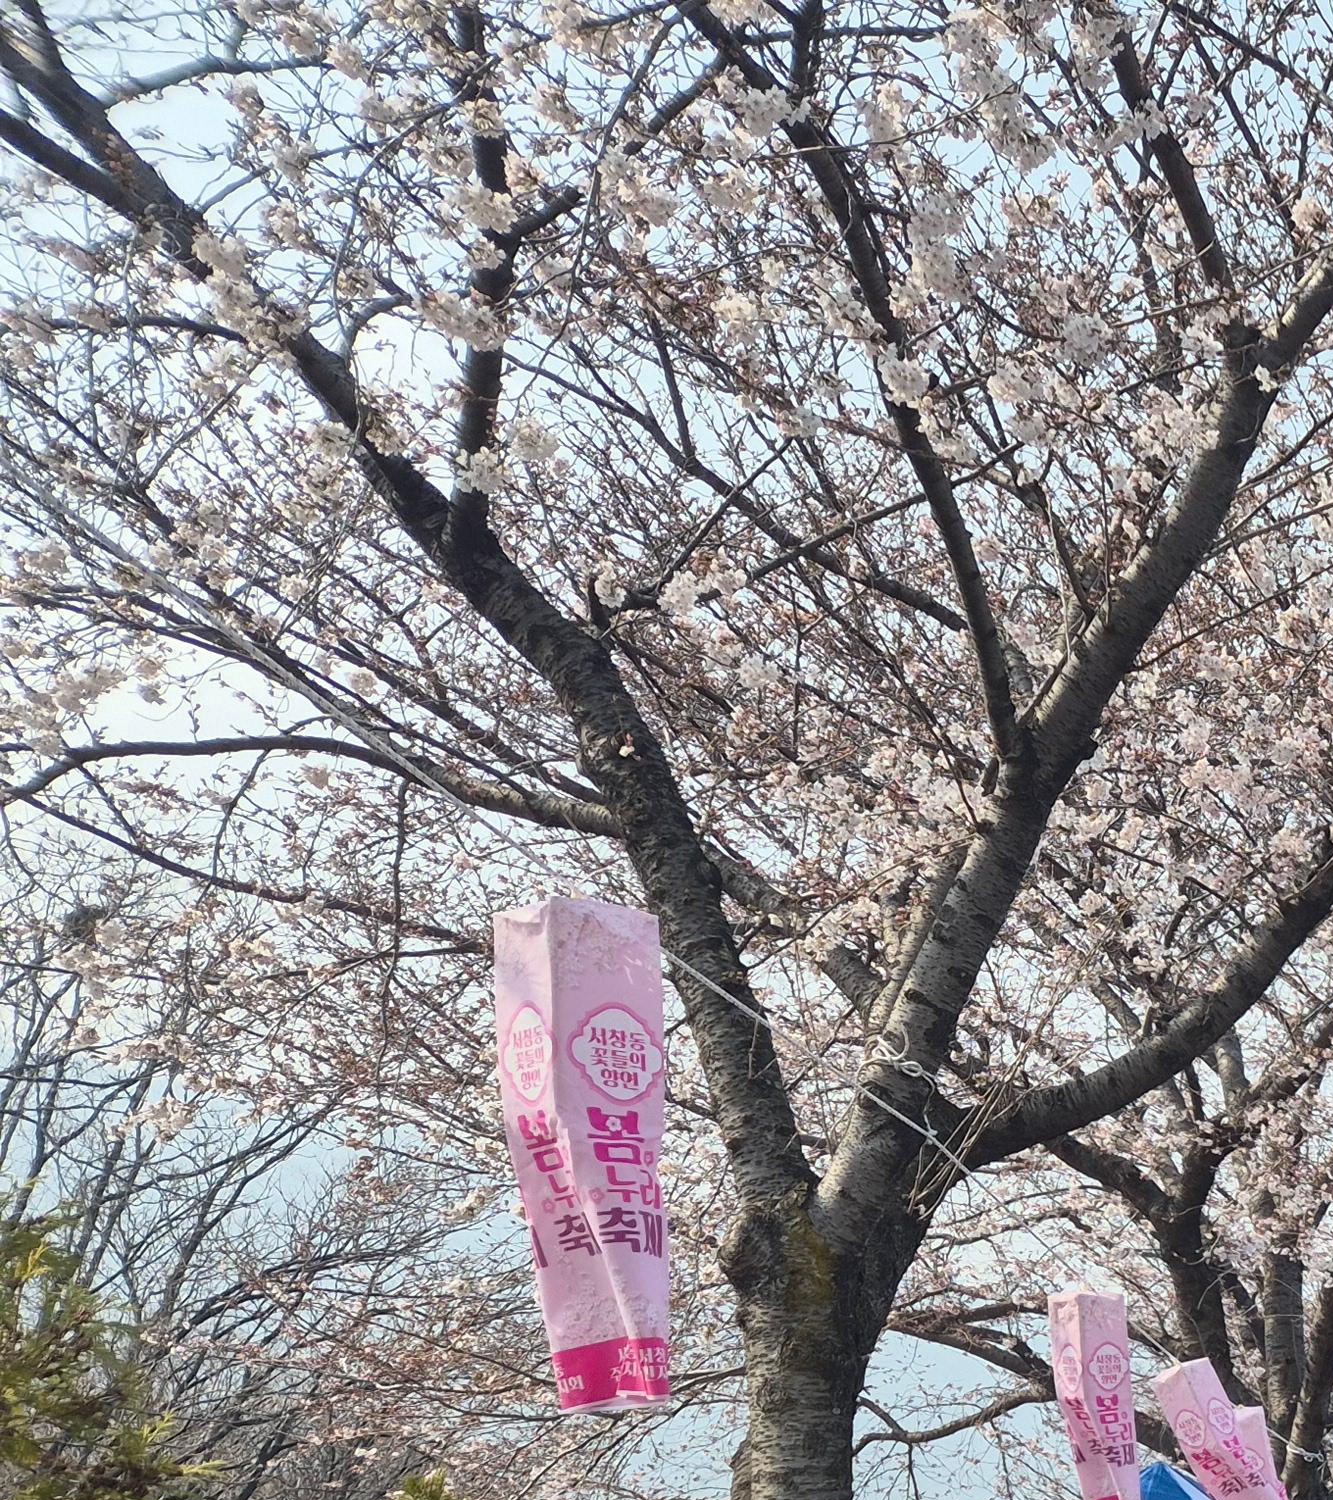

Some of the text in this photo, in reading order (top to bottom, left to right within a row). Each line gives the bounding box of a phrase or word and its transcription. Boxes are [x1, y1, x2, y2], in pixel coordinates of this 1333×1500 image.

[587, 1026, 646, 1052] 서창동
[591, 1047, 647, 1073] 꽃들의
[600, 1068, 640, 1091] 향연
[586, 1106, 644, 1166] 봄
[597, 1206, 663, 1258] 축제
